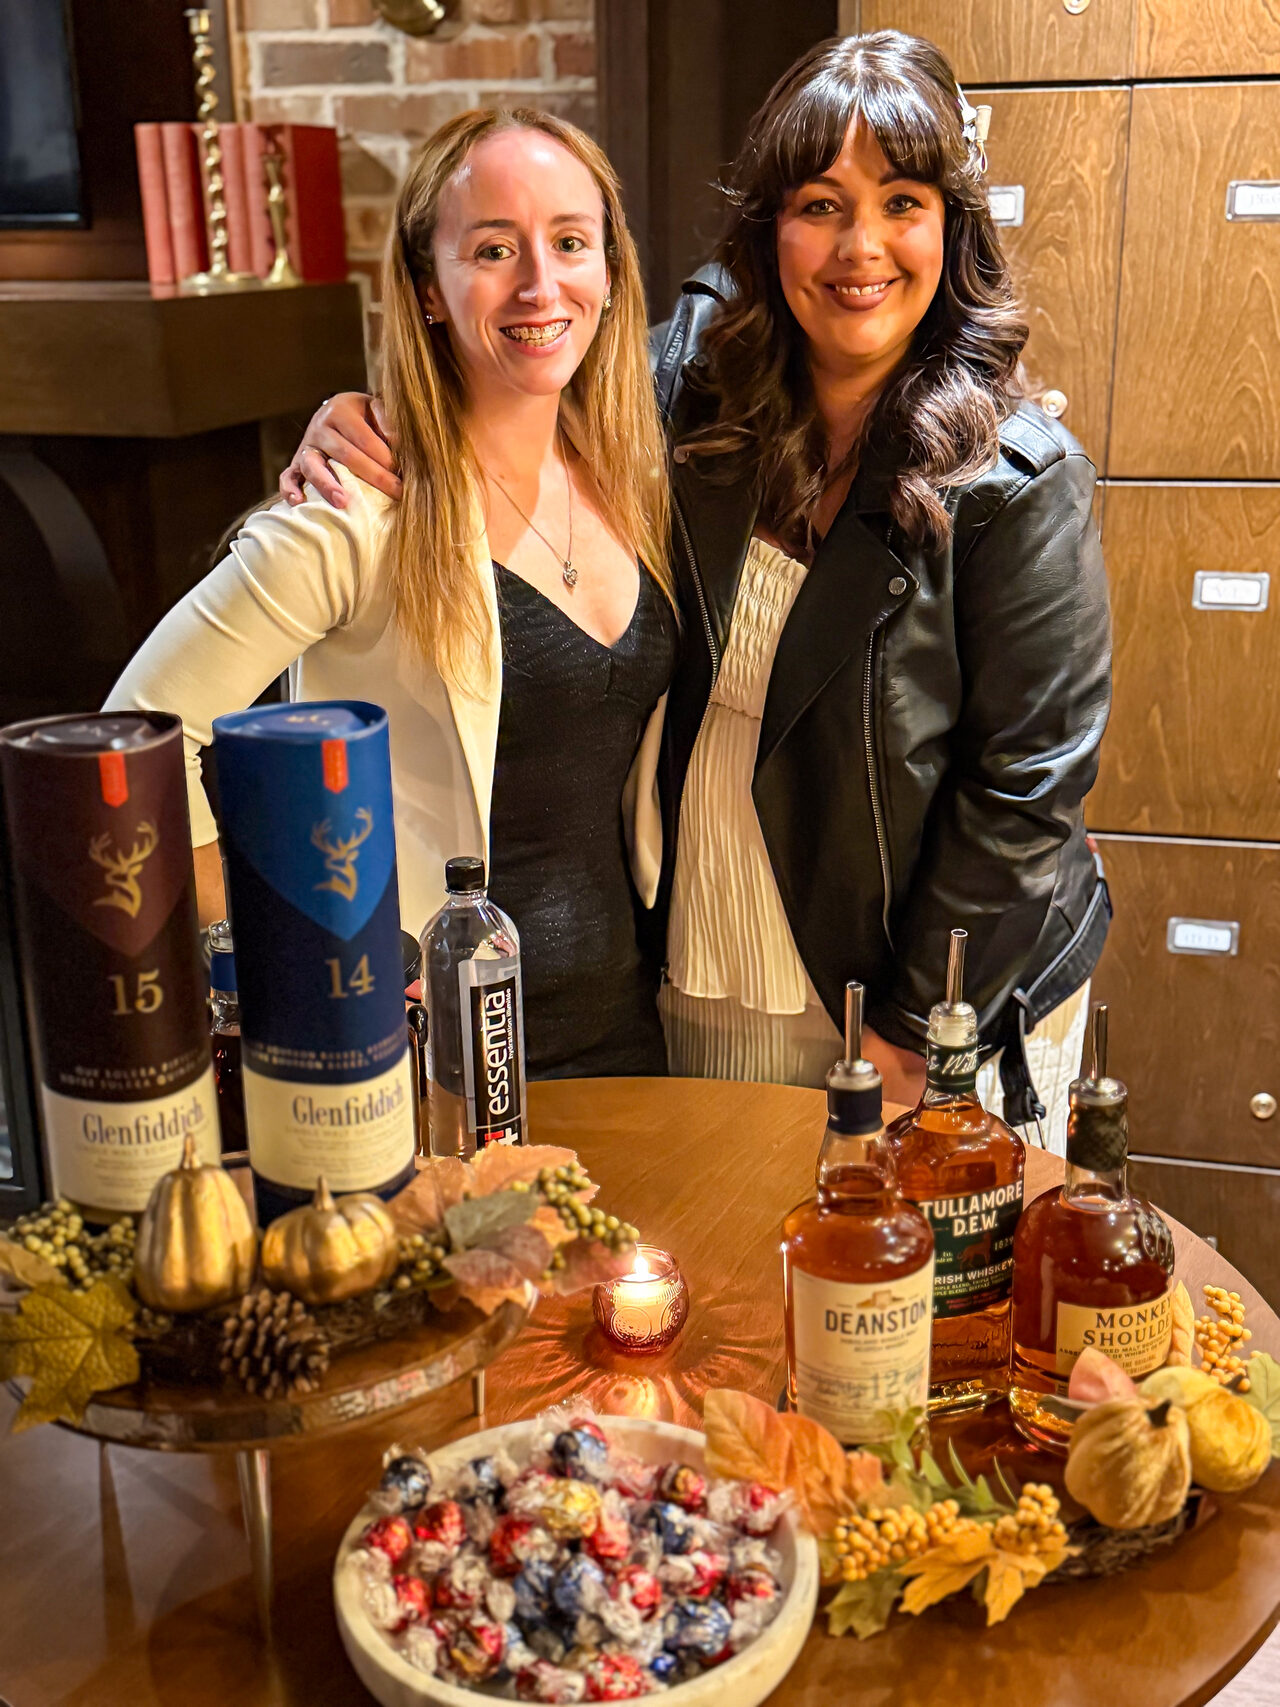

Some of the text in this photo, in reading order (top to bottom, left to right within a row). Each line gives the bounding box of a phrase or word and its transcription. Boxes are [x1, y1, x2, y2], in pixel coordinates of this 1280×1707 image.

[108, 968, 163, 1015] 15
[325, 953, 376, 999] 14
[481, 990, 510, 1116] essentia
[82, 1096, 204, 1146] Glenfiddich
[292, 1078, 404, 1127] Glenfiddich
[919, 1180, 1023, 1220] TULLAMORE
[953, 1210, 998, 1238] D.E.W.
[934, 1273, 963, 1285] RISH
[967, 1258, 1013, 1281] WHISKEY
[825, 1295, 928, 1335] DEANSTON
[1083, 1313, 1170, 1346] SHOULDE
[1096, 1296, 1171, 1329] MONKEY
[871, 1368, 901, 1400] 12
